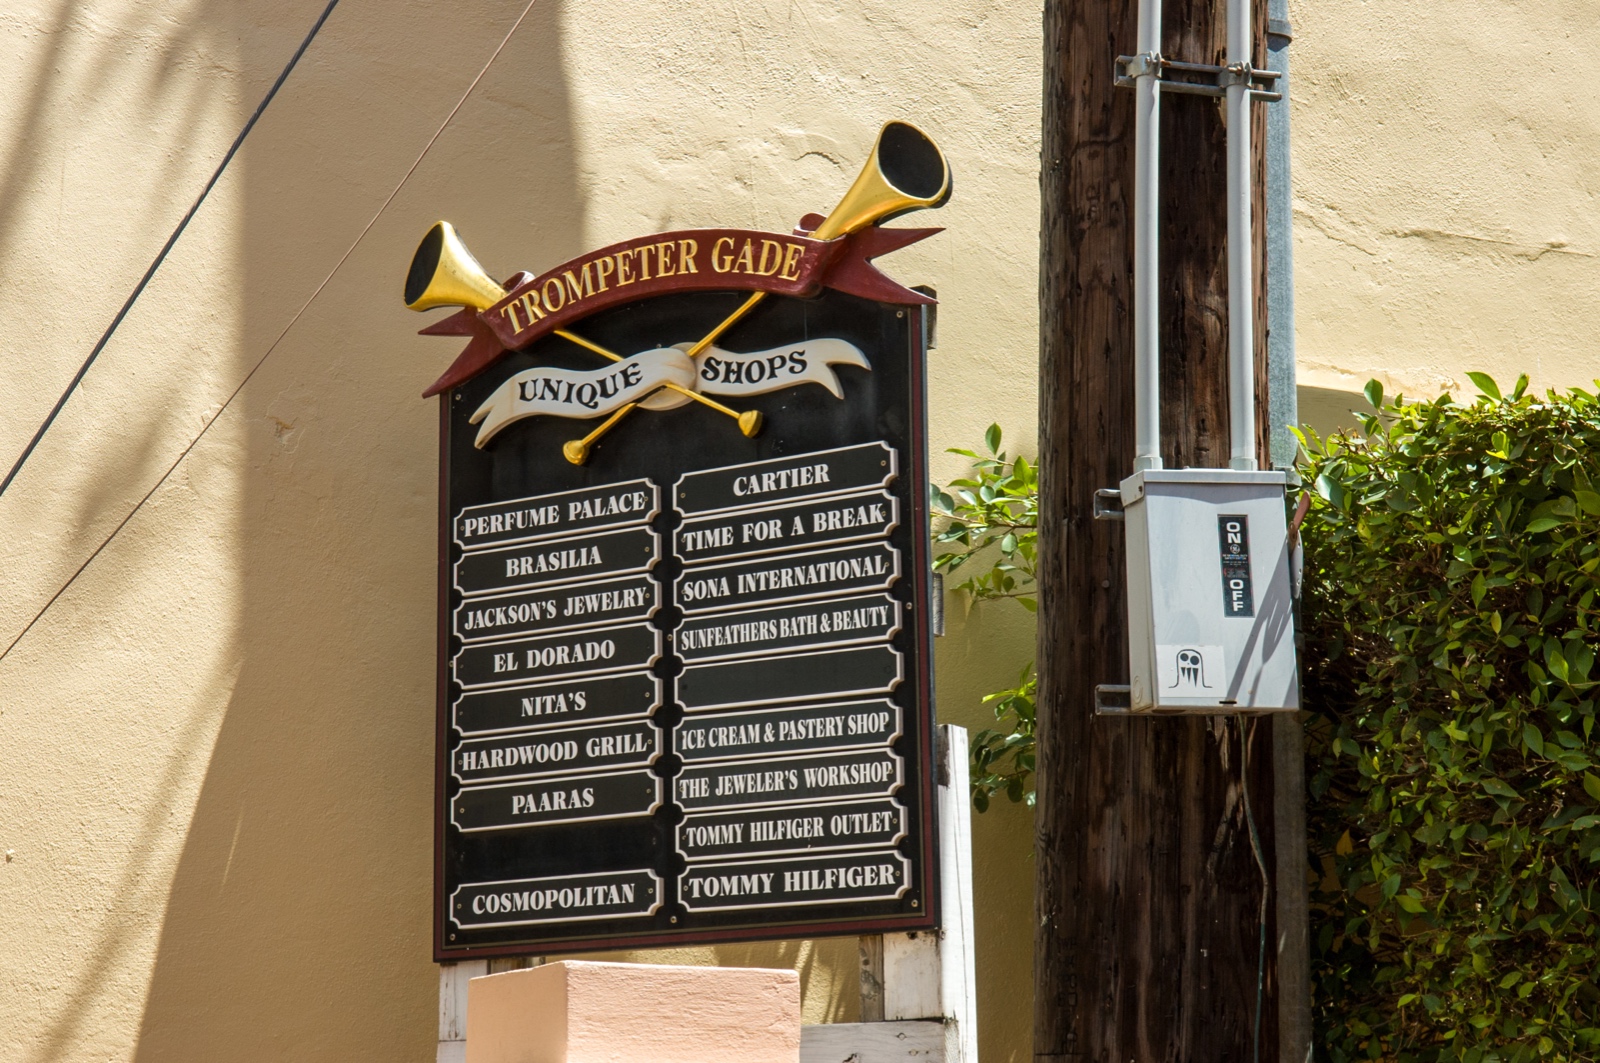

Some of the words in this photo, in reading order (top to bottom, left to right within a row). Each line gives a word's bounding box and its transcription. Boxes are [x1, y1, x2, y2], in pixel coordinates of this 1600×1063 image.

[501, 239, 698, 336] TROMPETER
[711, 237, 806, 281] GADE
[518, 362, 643, 409] UNIQUE
[701, 350, 807, 384] SHOPS
[733, 463, 830, 496] CARTIER
[464, 505, 560, 537] PERFUME
[568, 491, 646, 521] PALACE
[683, 526, 734, 551] TIME
[742, 519, 783, 543] FOR
[791, 515, 805, 536] A
[812, 503, 885, 533] BREAK
[1226, 522, 1241, 543] ON
[506, 545, 602, 578] BRASILIA
[683, 576, 730, 601] SONA
[737, 555, 886, 594] INTERNATIONAL
[464, 600, 557, 630] JACKSON'S
[563, 587, 647, 616] JEWELRY
[1229, 579, 1244, 611] OFF
[681, 619, 777, 650] SUNFEATHERS
[779, 614, 818, 638] BATH
[820, 612, 831, 633] &
[832, 605, 889, 632] BEAUTY
[493, 652, 518, 673] EL
[526, 639, 615, 669] DORADO
[521, 691, 586, 717] NITA'S
[682, 729, 706, 750] ICE
[708, 723, 760, 747] CREAM
[763, 722, 775, 743] &
[779, 716, 845, 741] PASTERY
[847, 712, 889, 735] SHOP
[462, 740, 578, 771] HARDWOOD
[586, 733, 647, 757] GRILL
[679, 777, 710, 798] THE
[715, 769, 798, 796] JEWELER'S
[803, 761, 892, 788] WORKSHOP
[512, 787, 595, 815] PAARAS
[686, 823, 744, 847] TOMMY
[750, 816, 824, 842] HILFIGER
[830, 811, 893, 836] OUTLET
[472, 883, 635, 915] COSMOPOLITAN
[688, 872, 774, 898] TOMMY
[784, 864, 896, 892] HILFIGER
